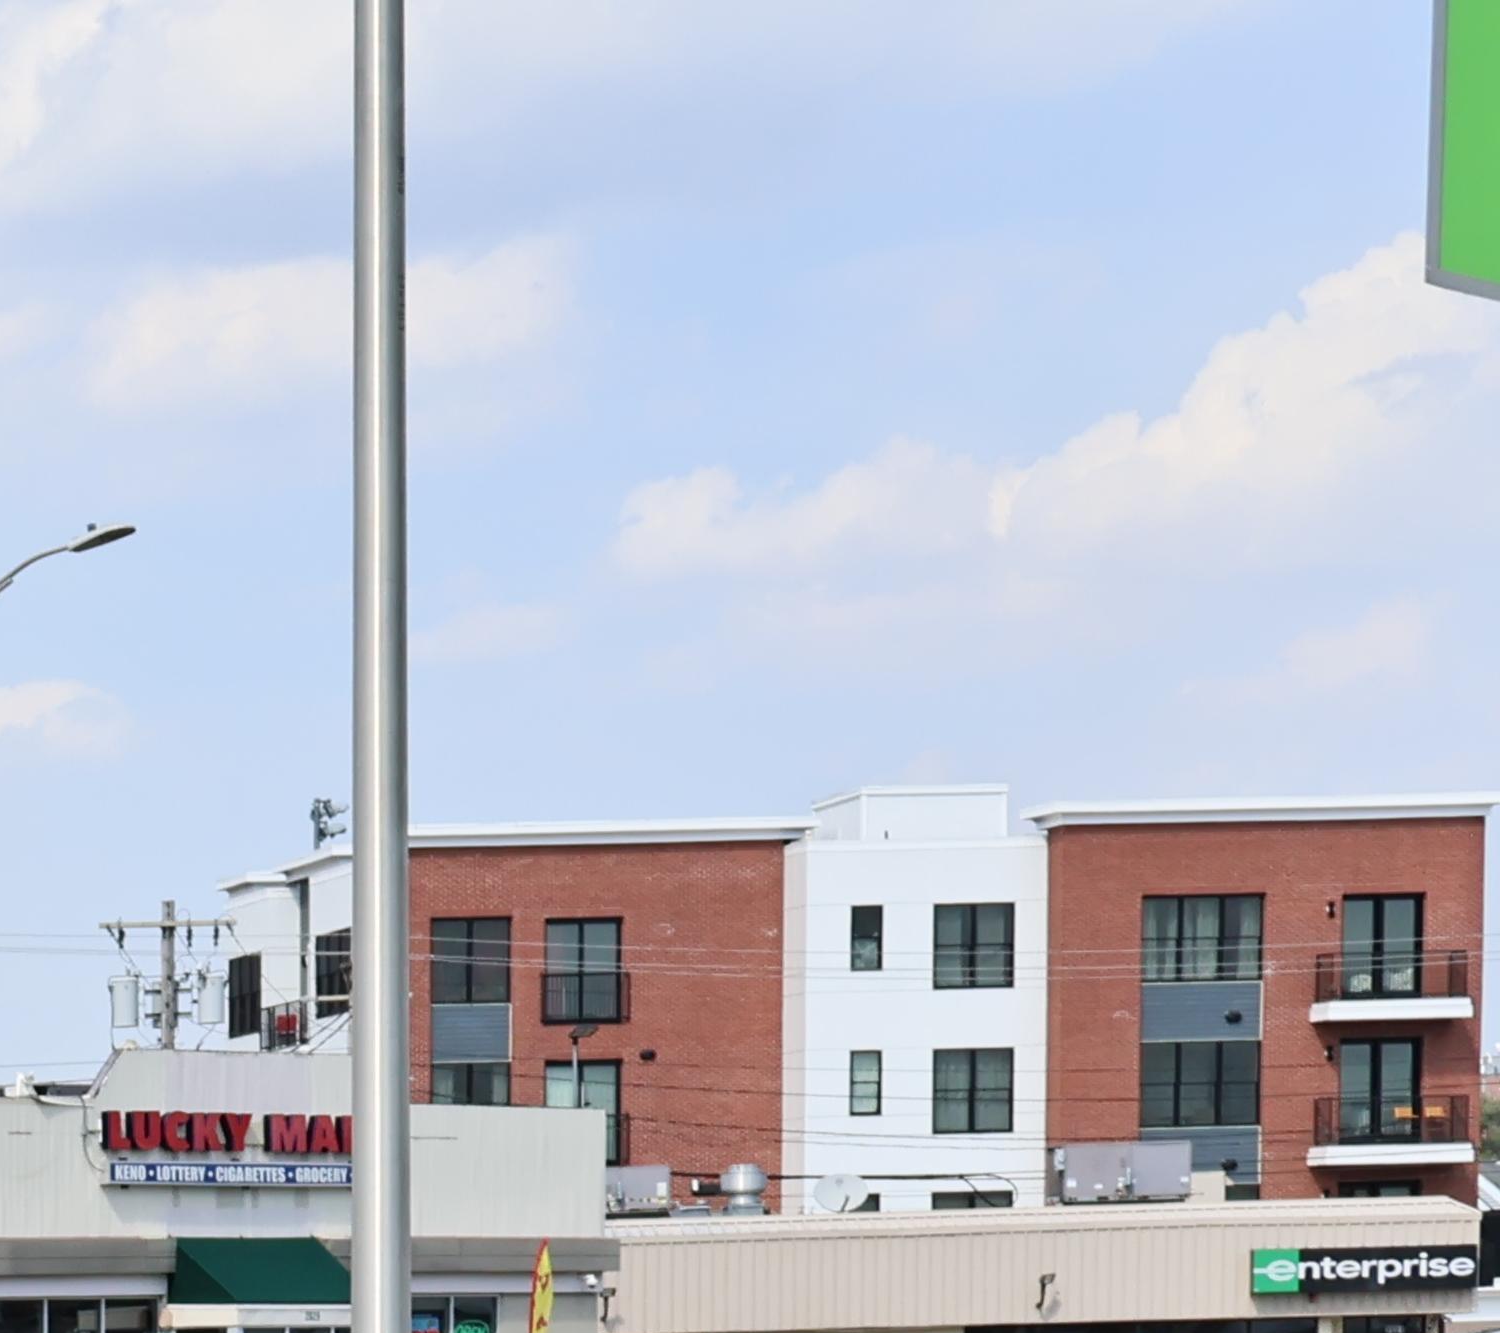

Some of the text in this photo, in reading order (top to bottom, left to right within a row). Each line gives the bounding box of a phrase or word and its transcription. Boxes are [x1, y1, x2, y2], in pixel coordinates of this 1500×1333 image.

[101, 1110, 252, 1152] LUCKY
[114, 1164, 347, 1183] KENO LOTTERY CIGARETTES GROCERY
[1253, 1252, 1475, 1285] enterprise
